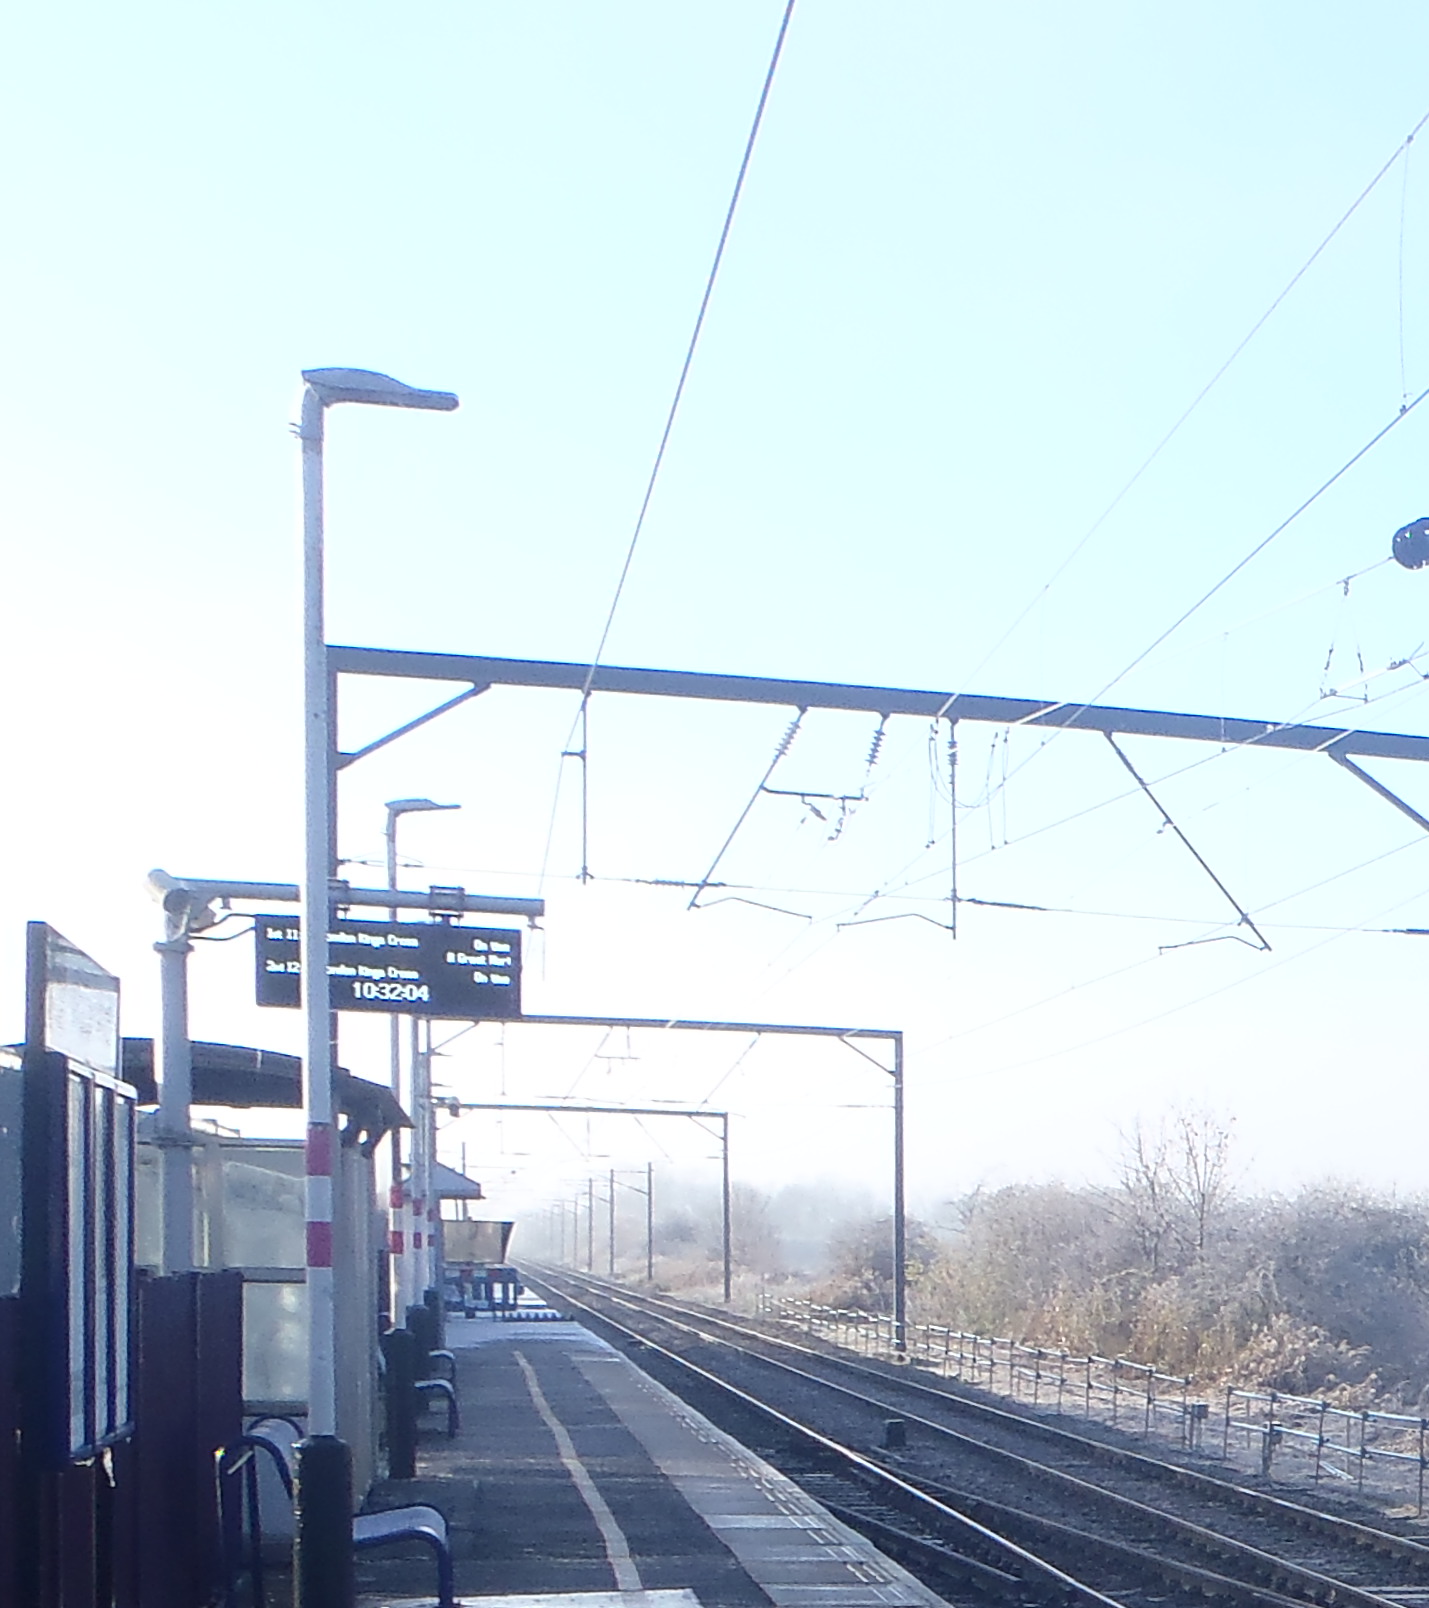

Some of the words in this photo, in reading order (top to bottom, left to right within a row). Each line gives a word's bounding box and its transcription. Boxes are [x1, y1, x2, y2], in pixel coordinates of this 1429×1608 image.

[325, 931, 357, 944] ondon
[325, 964, 357, 977] ondon
[352, 981, 430, 1002] 10:32:04
